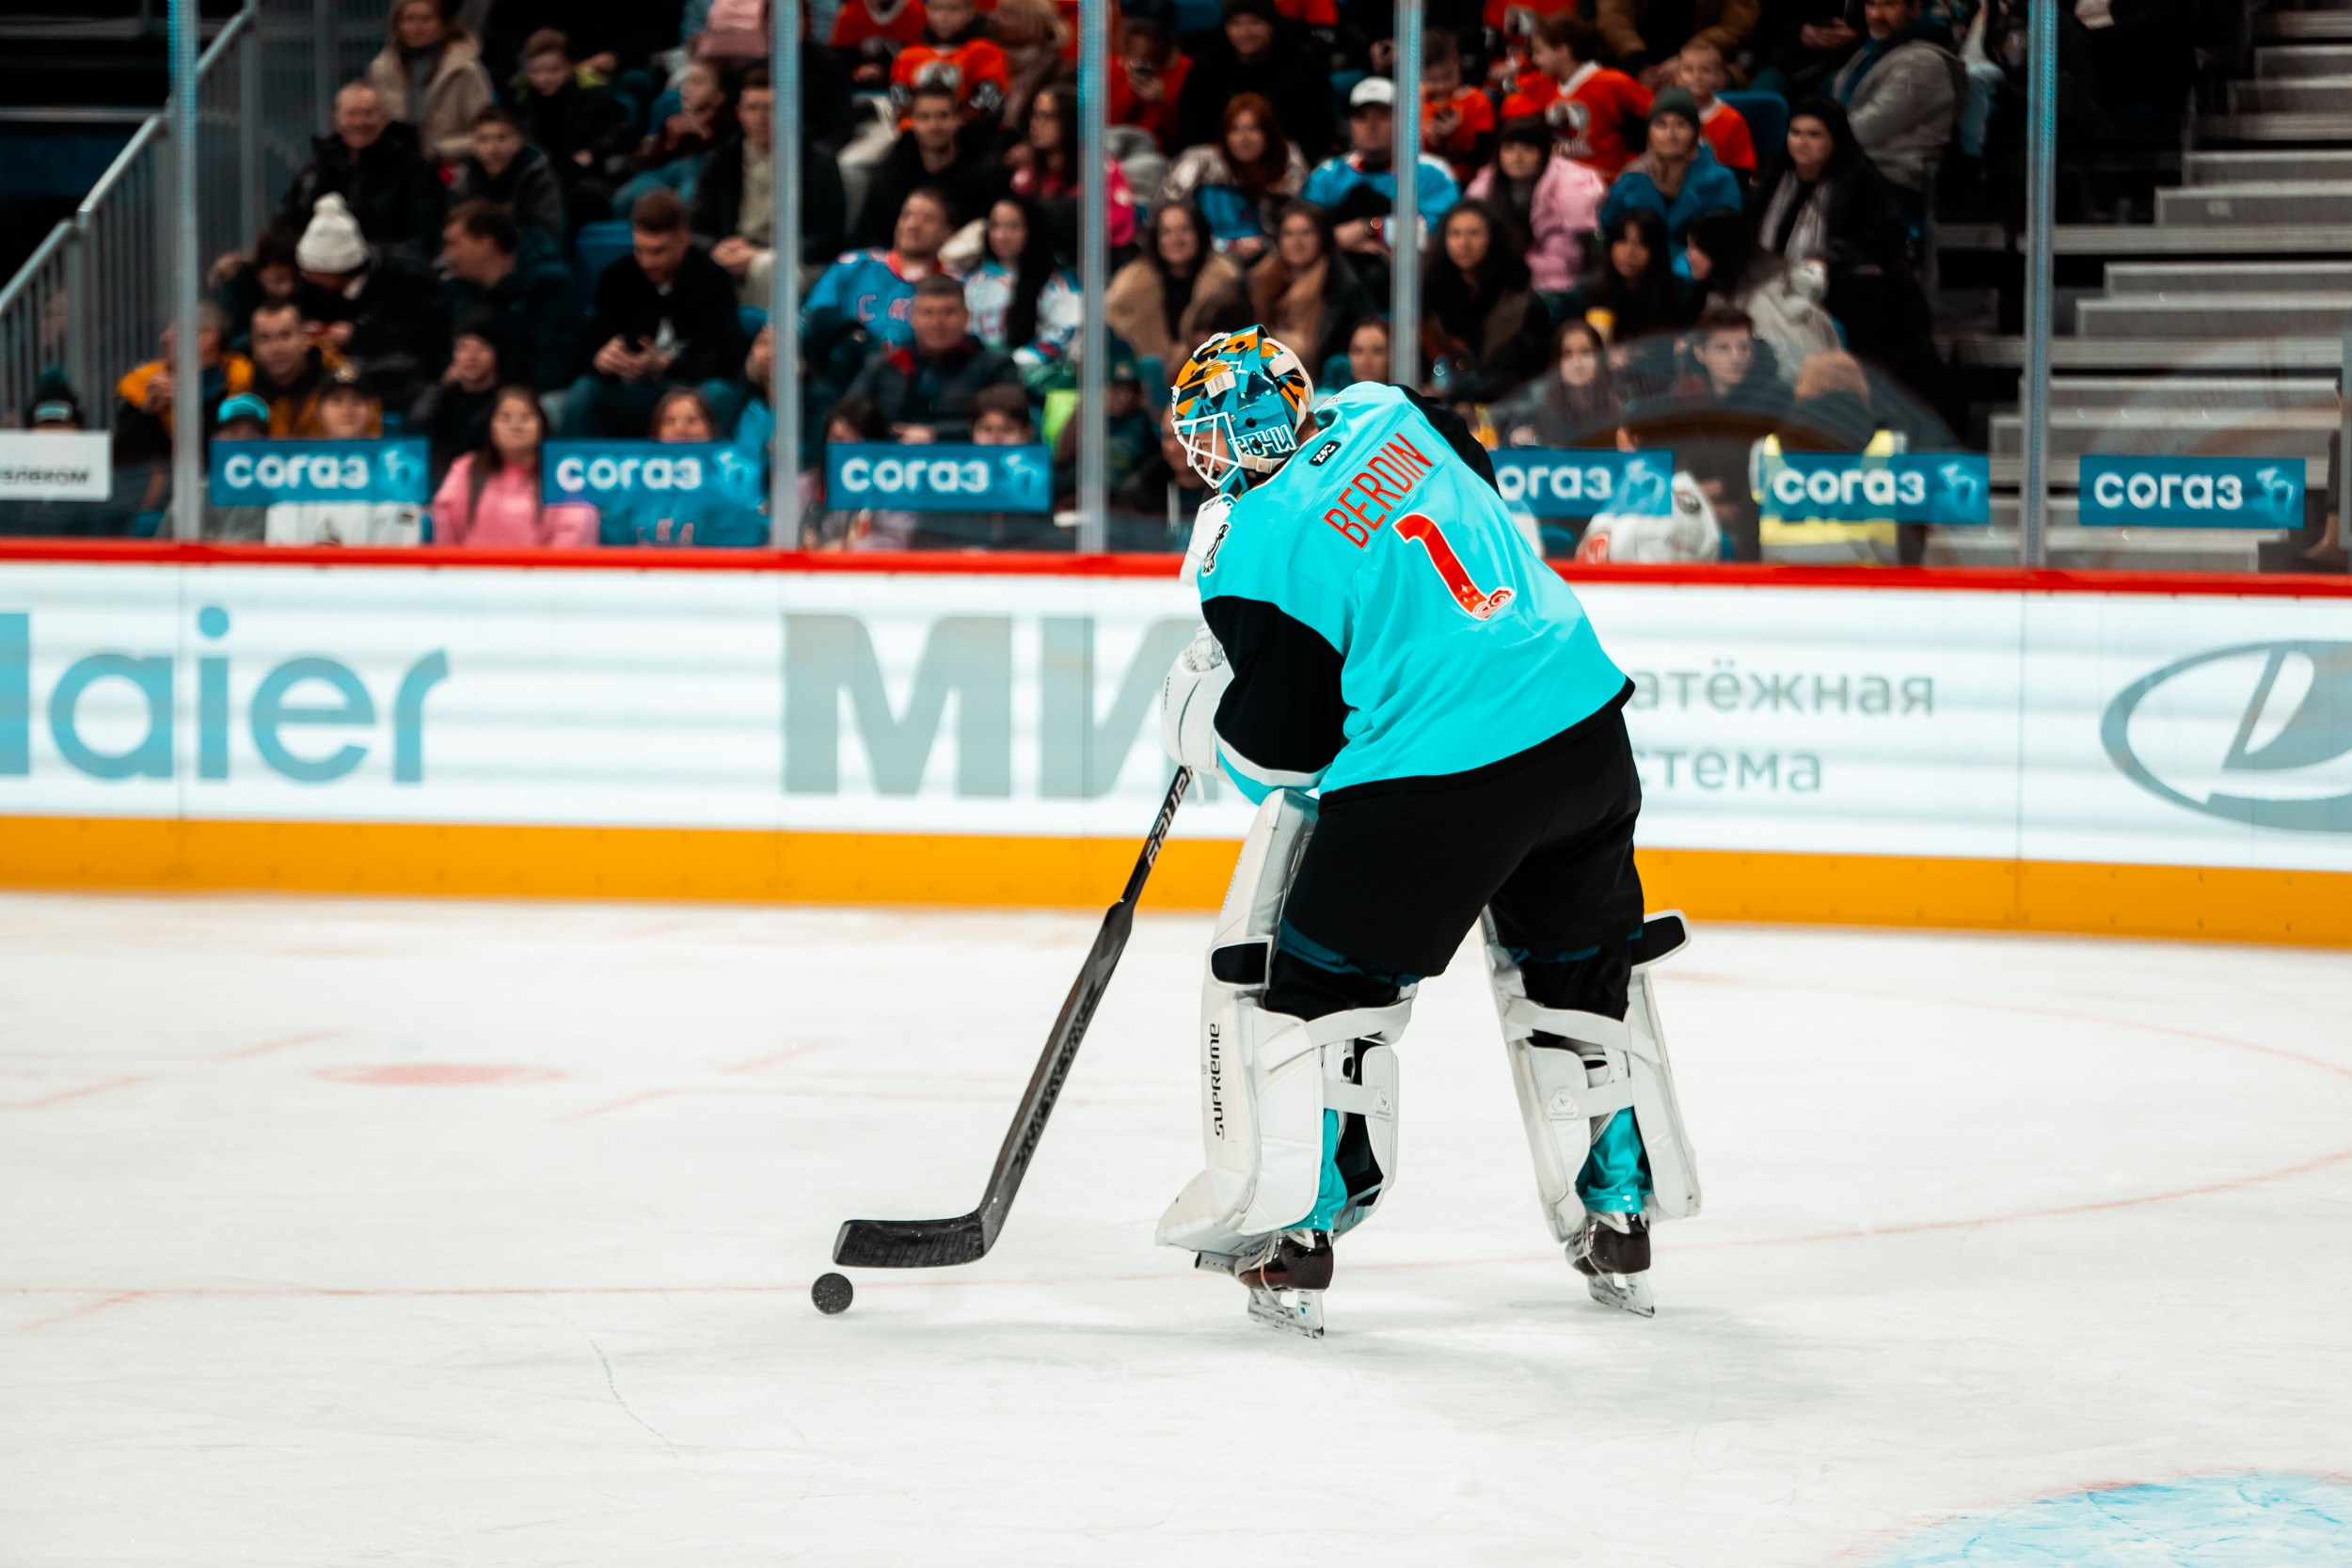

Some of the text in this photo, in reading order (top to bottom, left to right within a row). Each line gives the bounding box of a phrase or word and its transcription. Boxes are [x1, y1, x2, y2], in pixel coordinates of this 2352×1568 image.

[1323, 432, 1434, 549] BERDIN
[1393, 514, 1516, 620] 1
[1210, 1022, 1224, 1140] SUPREME
